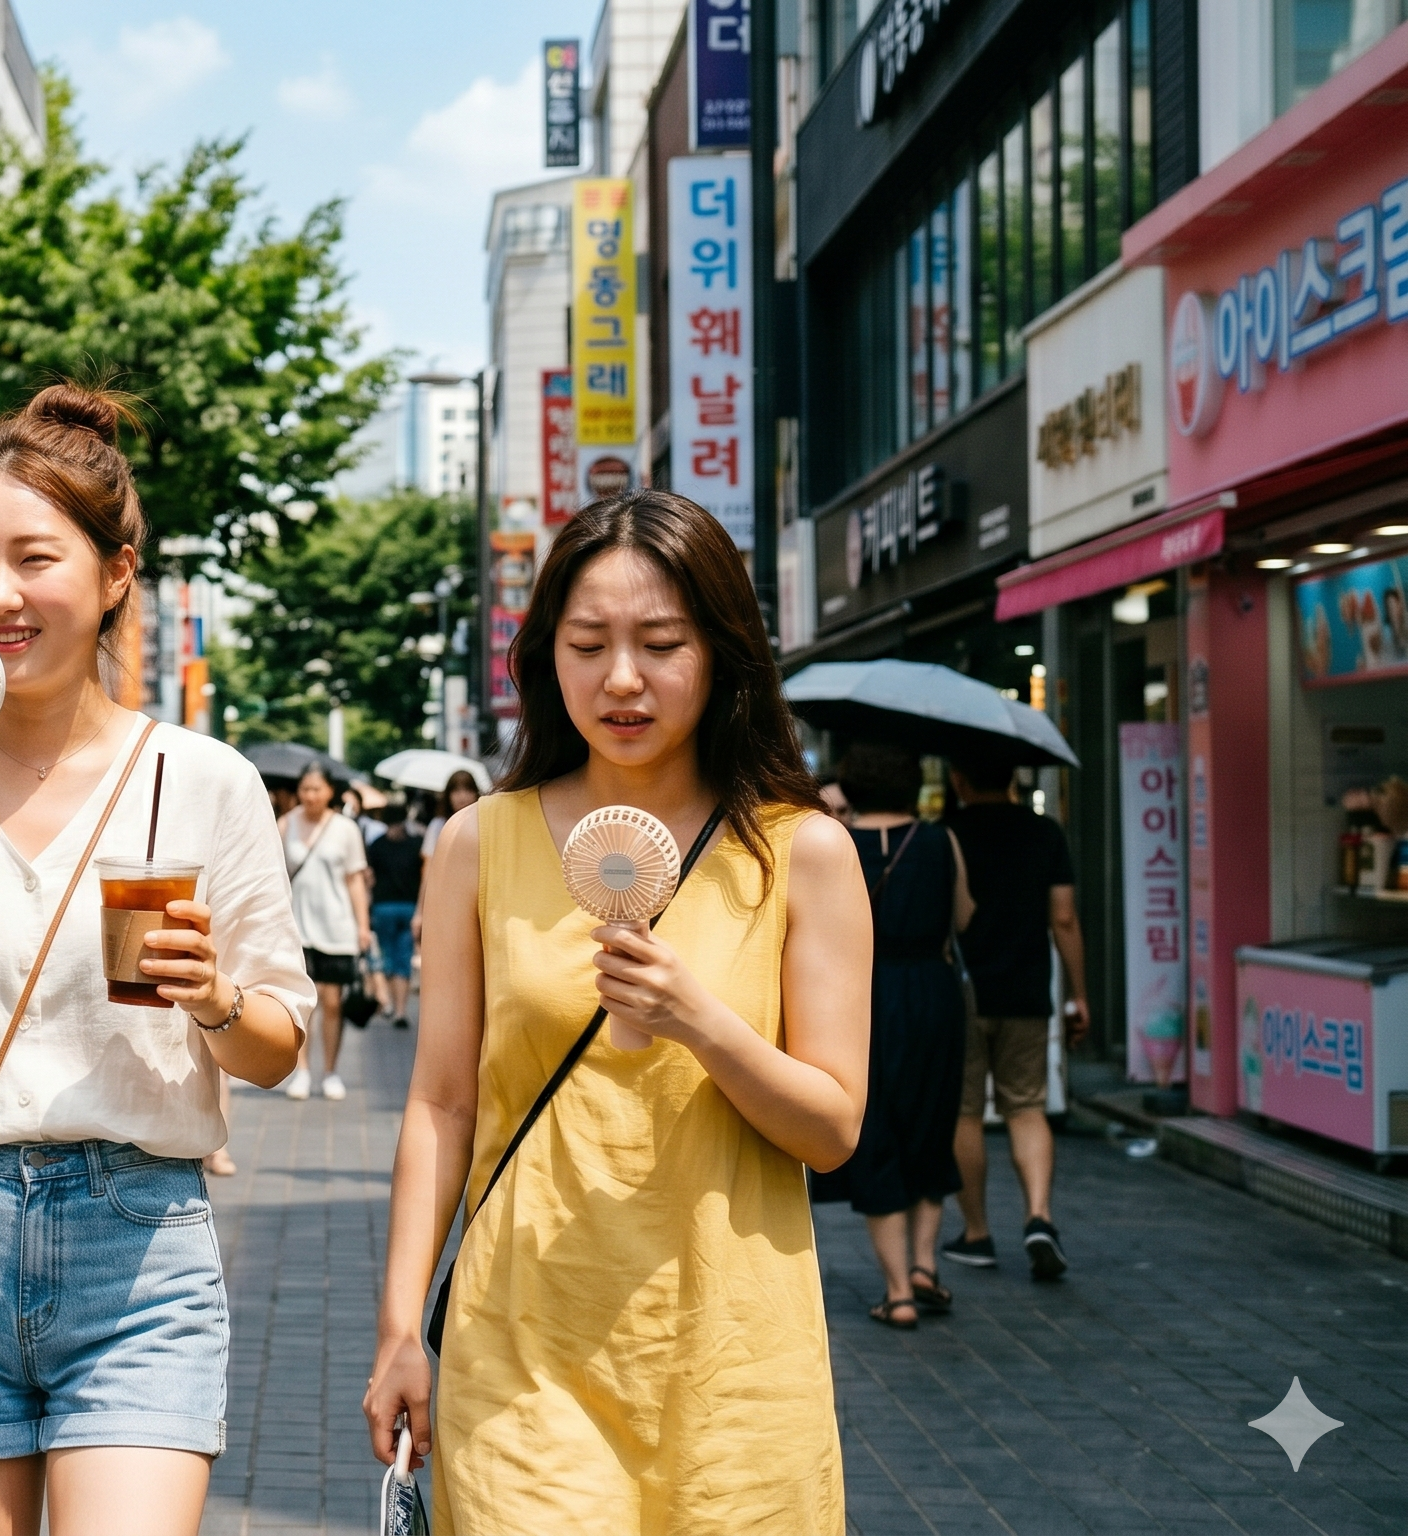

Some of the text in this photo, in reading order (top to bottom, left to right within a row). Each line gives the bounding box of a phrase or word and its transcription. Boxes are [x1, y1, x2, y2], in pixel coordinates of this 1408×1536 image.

[707, 0, 751, 54] 더
[1140, 766, 1180, 963] 아이스크림
[1264, 1006, 1363, 1092] 아이스크림
